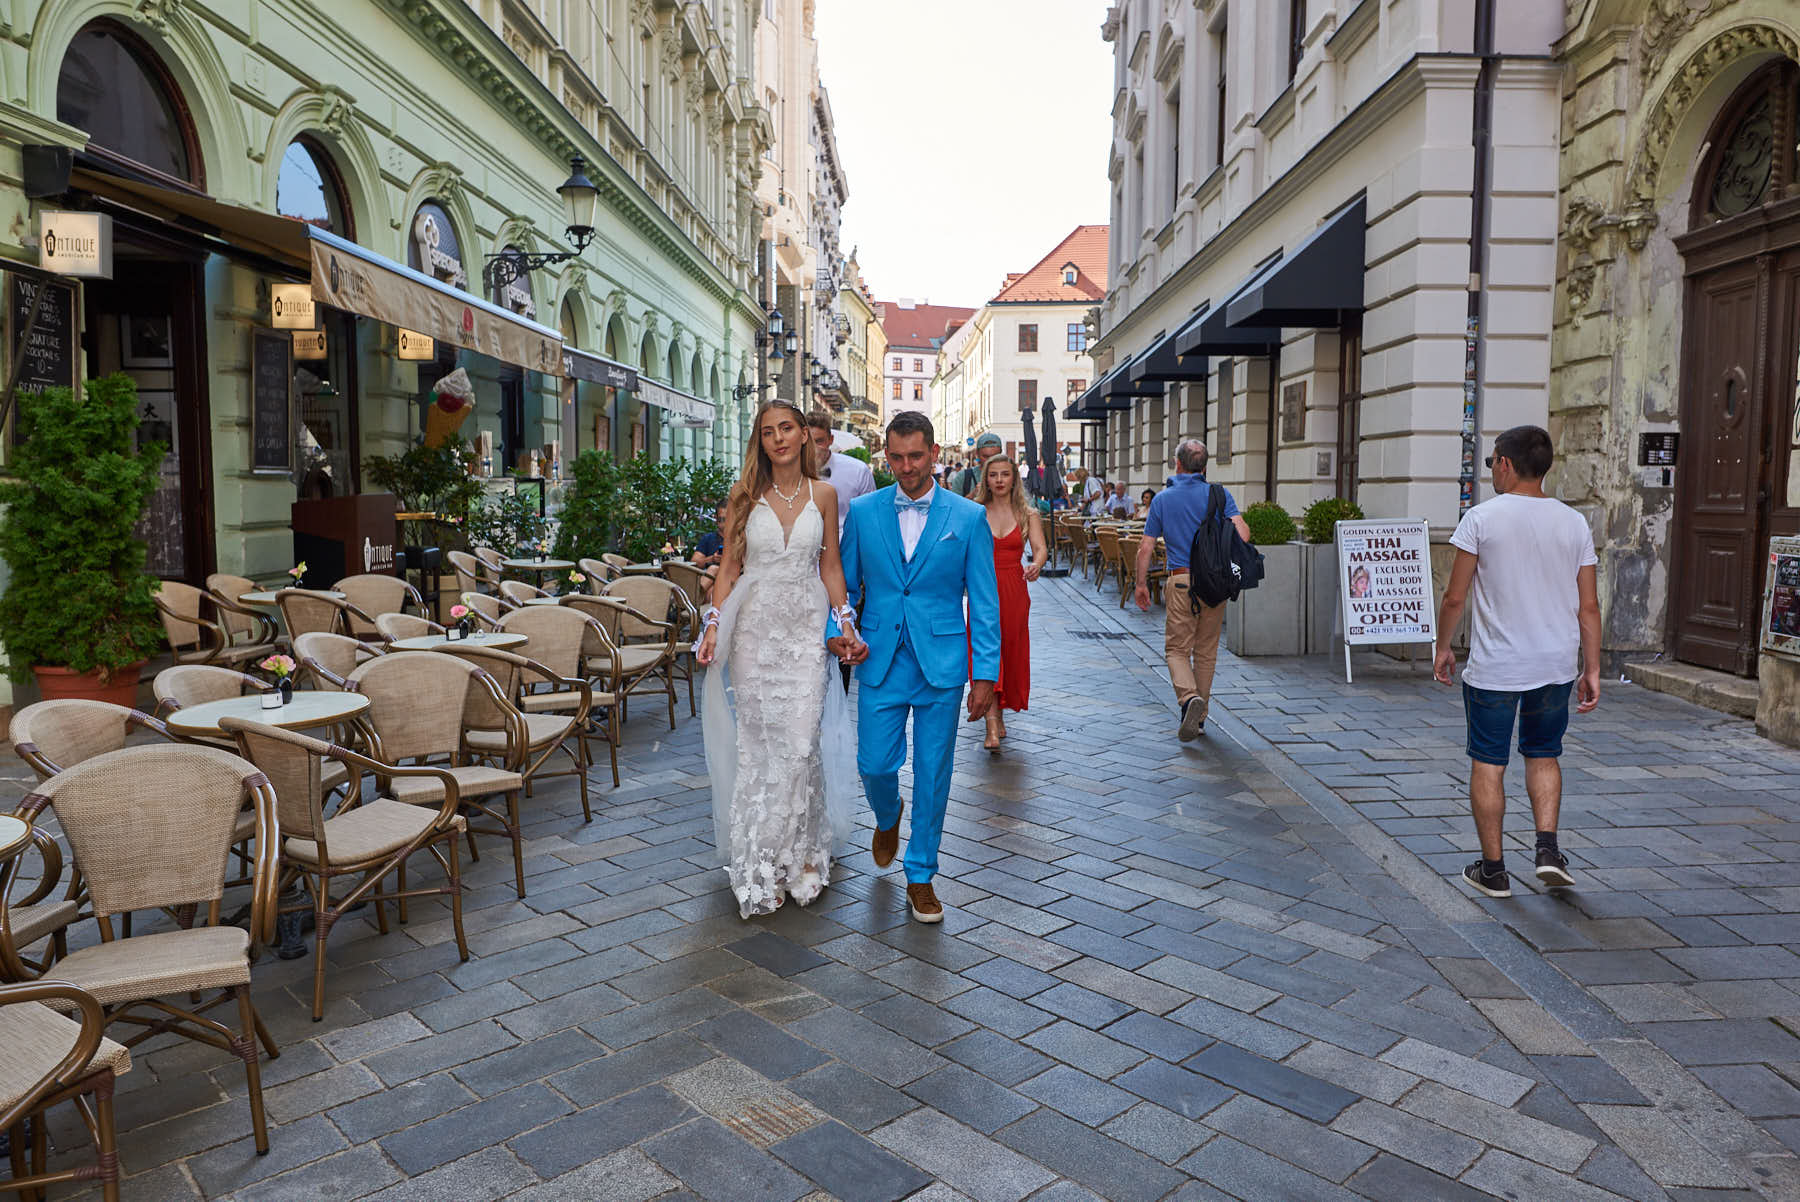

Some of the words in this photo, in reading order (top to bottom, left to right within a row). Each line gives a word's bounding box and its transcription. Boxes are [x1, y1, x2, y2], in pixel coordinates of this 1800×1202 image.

[1343, 528, 1374, 536] GOLDEN
[1376, 527, 1394, 535] CAVE
[1365, 537, 1402, 549] THAI
[1349, 549, 1420, 562] MASSAGE
[1375, 565, 1422, 574] EXCLUSIVE
[1376, 577, 1394, 585] FULL
[1400, 576, 1423, 585] BODY
[1376, 587, 1423, 596] MASSAGE
[1352, 601, 1425, 613] WELCOME
[1359, 613, 1419, 625] OPEN
